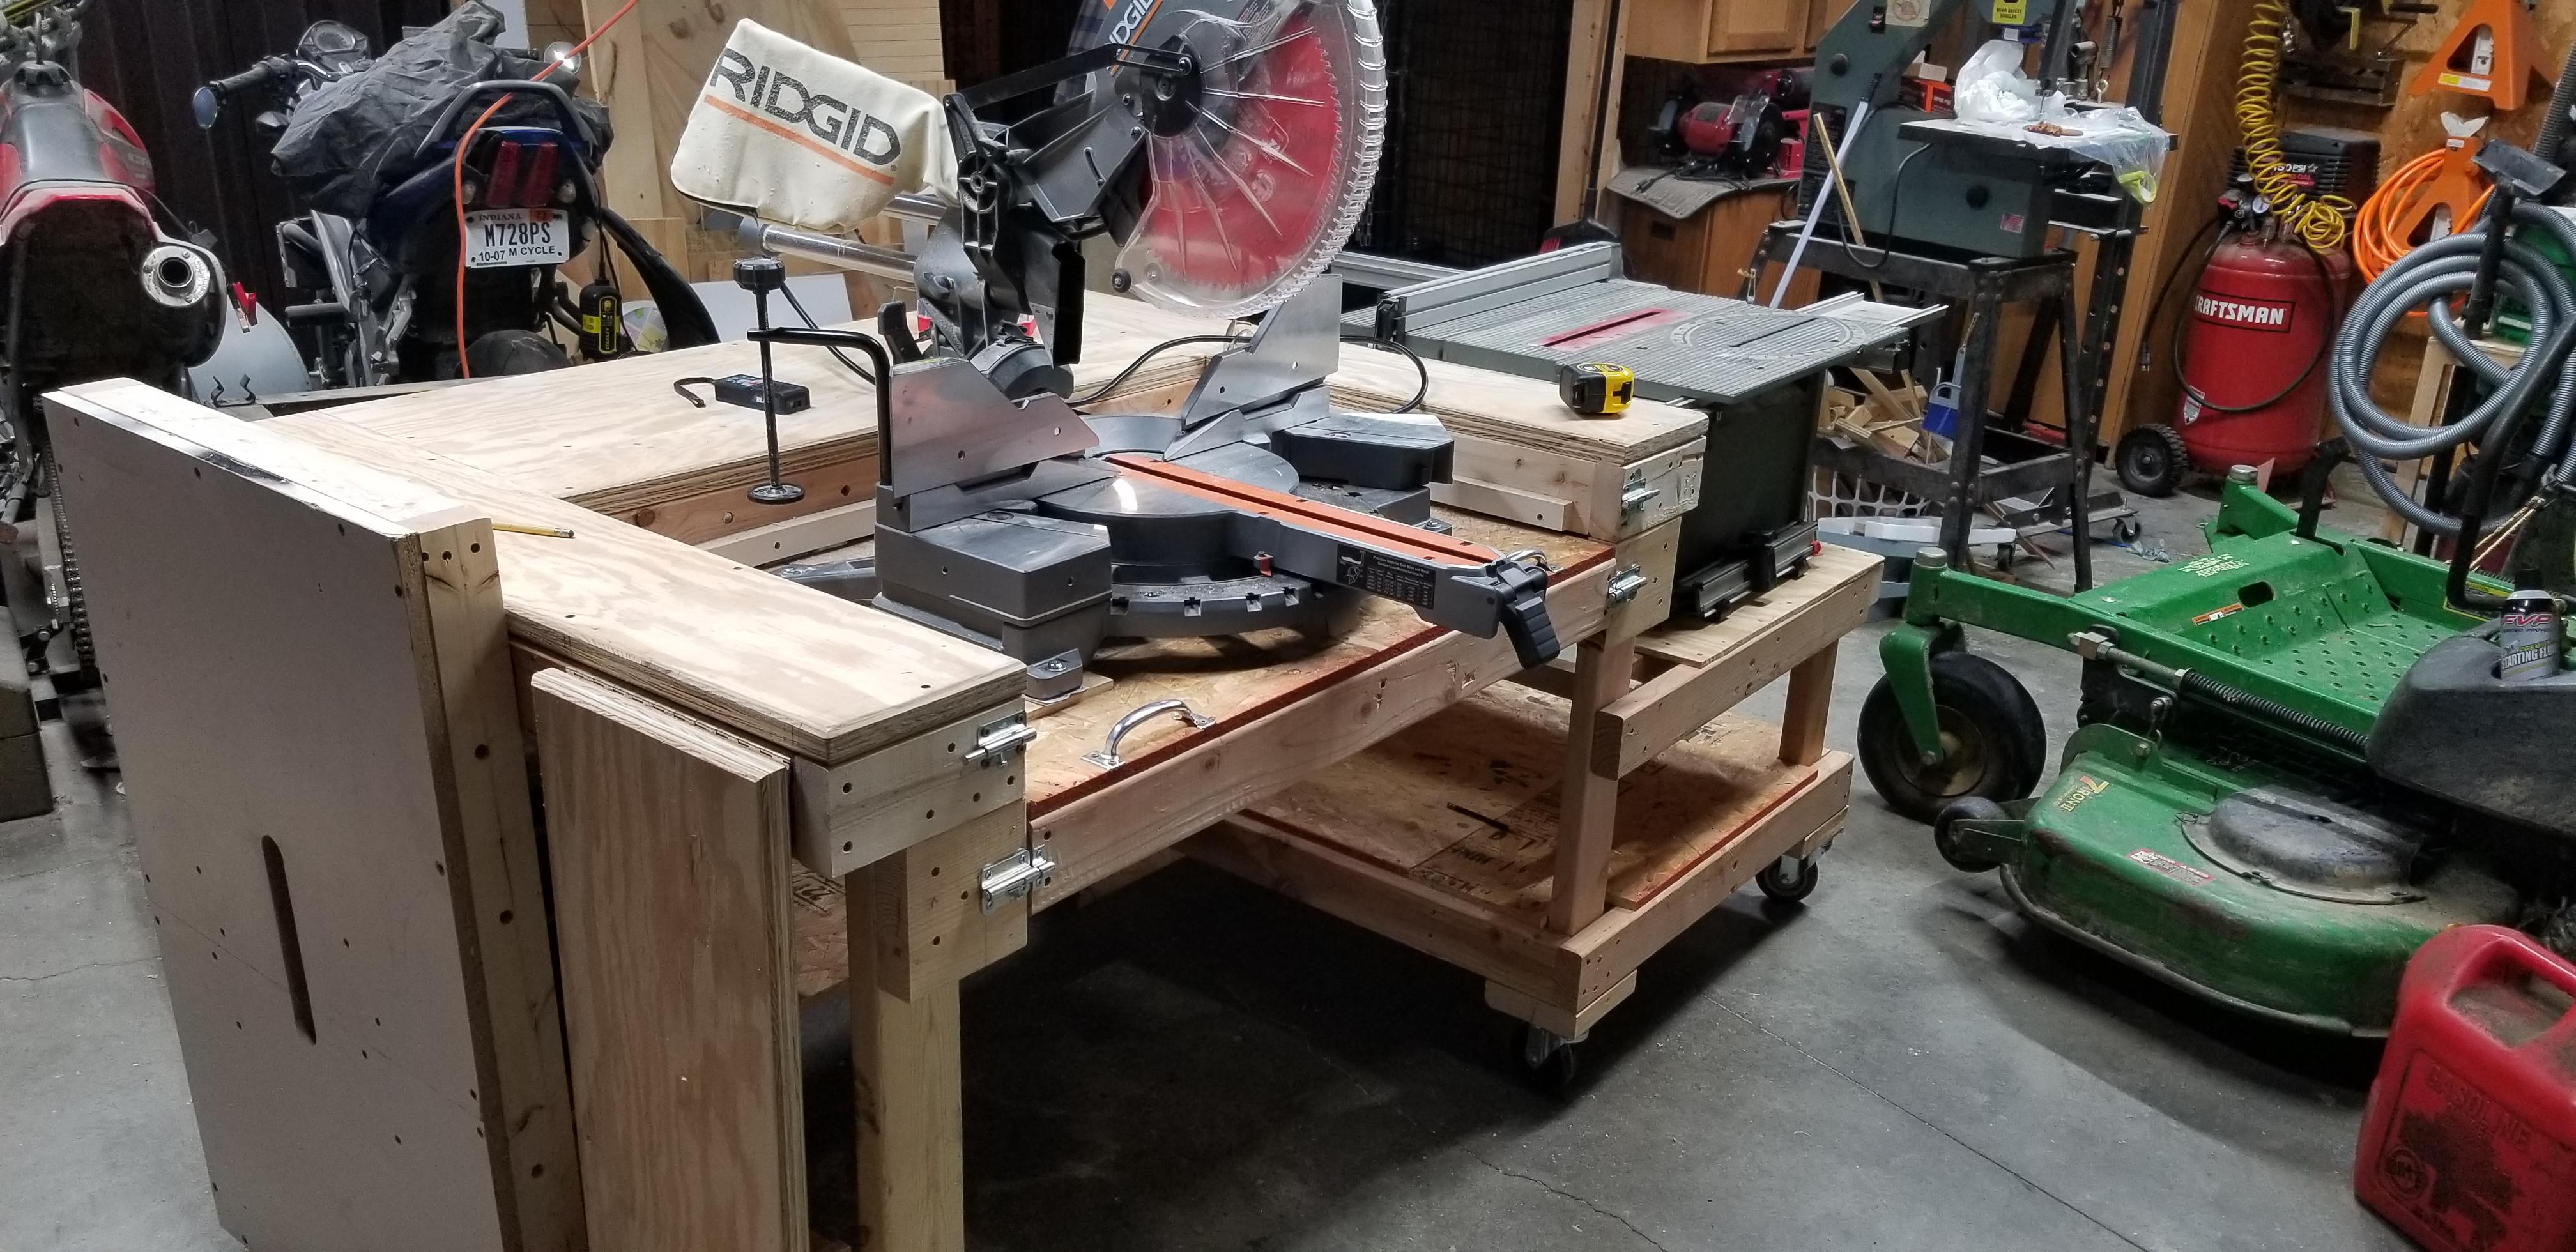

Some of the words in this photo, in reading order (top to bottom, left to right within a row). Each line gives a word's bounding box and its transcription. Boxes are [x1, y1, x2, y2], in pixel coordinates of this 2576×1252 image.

[710, 47, 901, 165] RIDGID
[479, 213, 522, 222] INDIANA
[484, 222, 551, 247] M728PS
[479, 250, 505, 261] 10-07
[521, 246, 556, 256] CYCLE
[2503, 614, 2553, 627] FVP
[2501, 650, 2538, 670] STARTING
